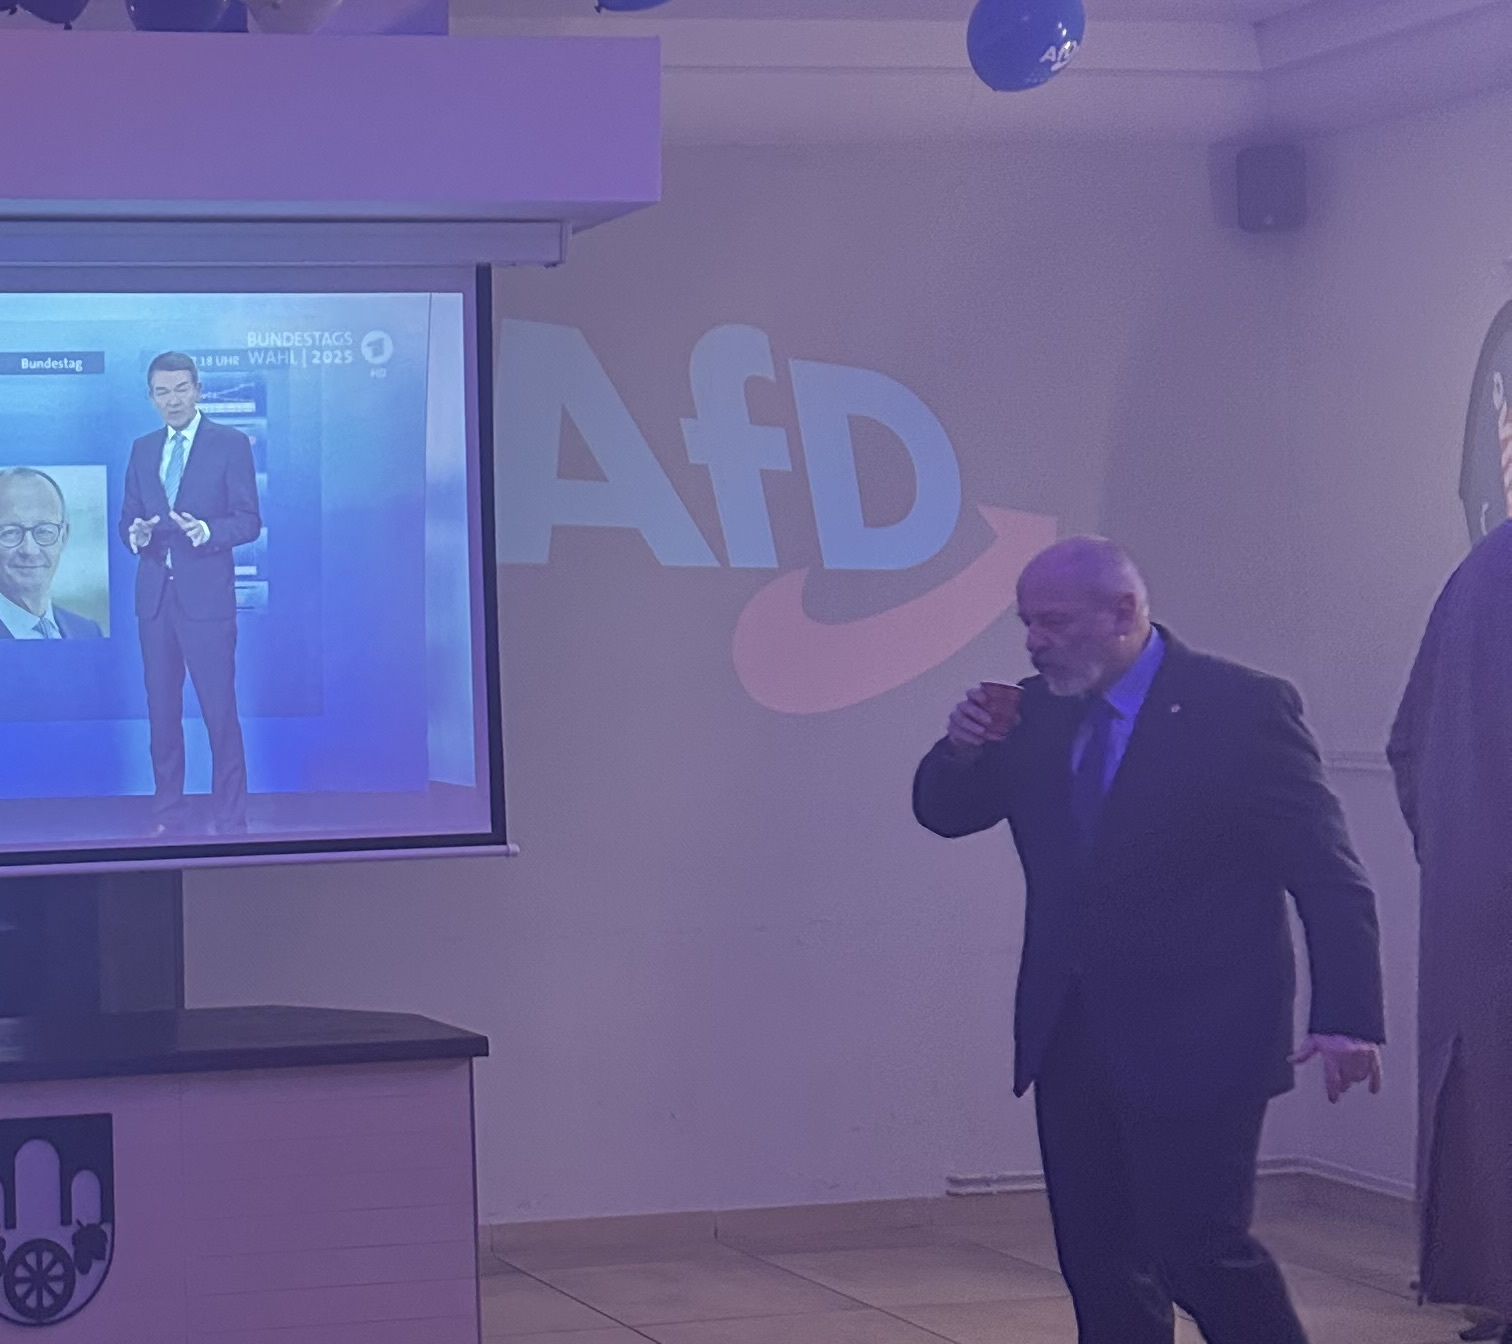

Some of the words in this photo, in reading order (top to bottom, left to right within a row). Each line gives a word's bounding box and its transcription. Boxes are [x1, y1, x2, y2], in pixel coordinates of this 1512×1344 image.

[246, 331, 354, 348] BUNDESTAGS
[20, 356, 83, 372] Bundestag
[248, 349, 297, 366] WAHL
[311, 348, 353, 365] 2025
[494, 318, 962, 570] AfD
